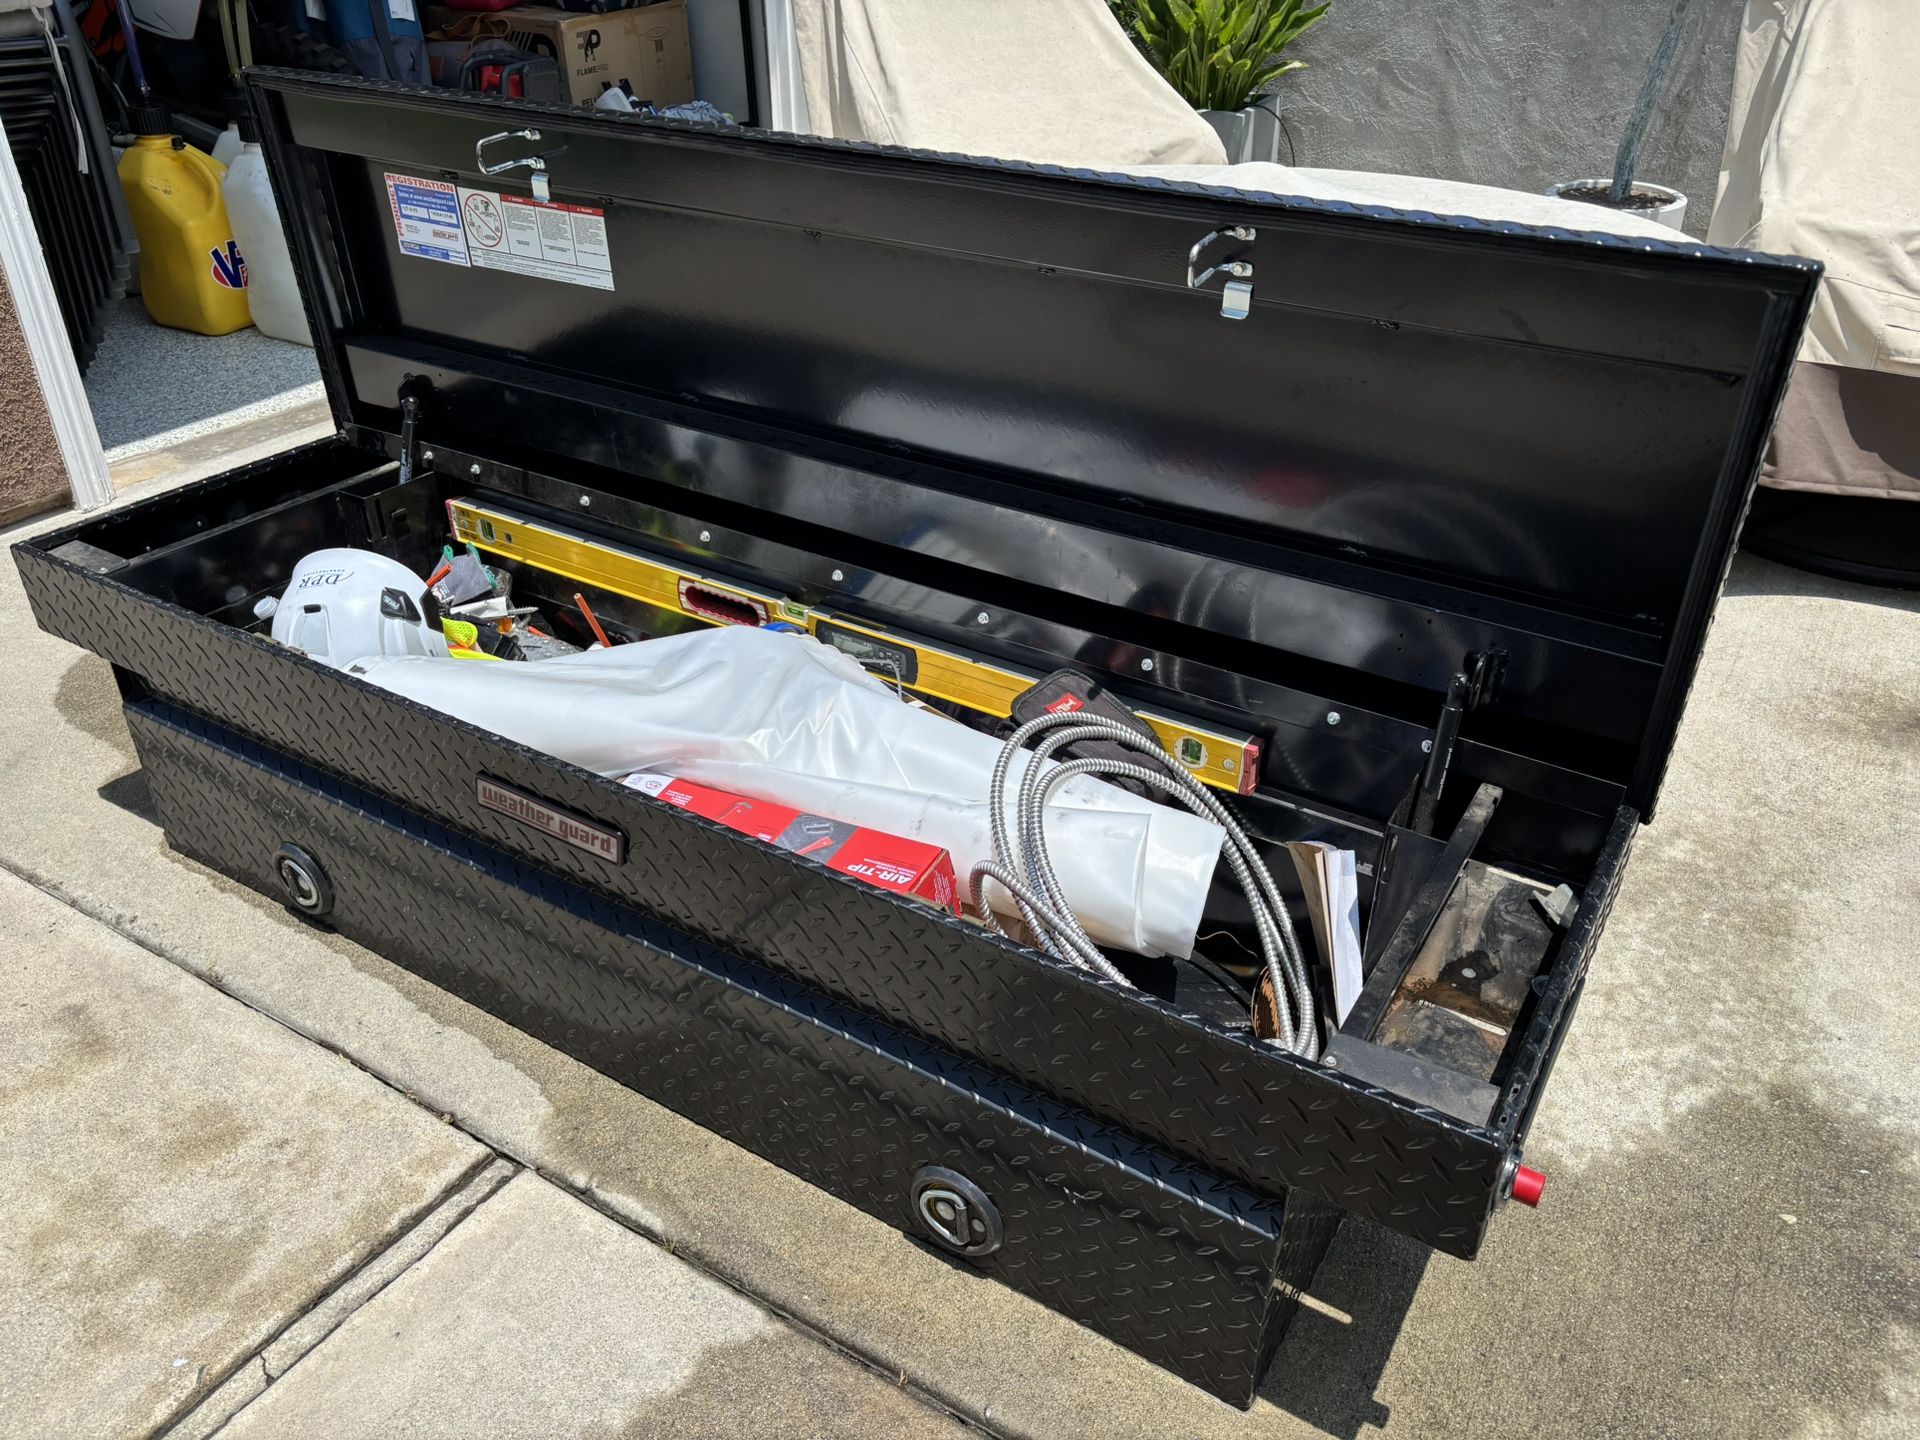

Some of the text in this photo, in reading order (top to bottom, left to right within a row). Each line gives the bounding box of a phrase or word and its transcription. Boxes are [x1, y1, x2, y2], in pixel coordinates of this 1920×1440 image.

[385, 175, 455, 193] REGISTRATION
[388, 184, 404, 237] PRODUCT
[299, 574, 340, 588] DPR
[482, 785, 612, 854] weather guard
[847, 863, 913, 885] AIR-TIP
